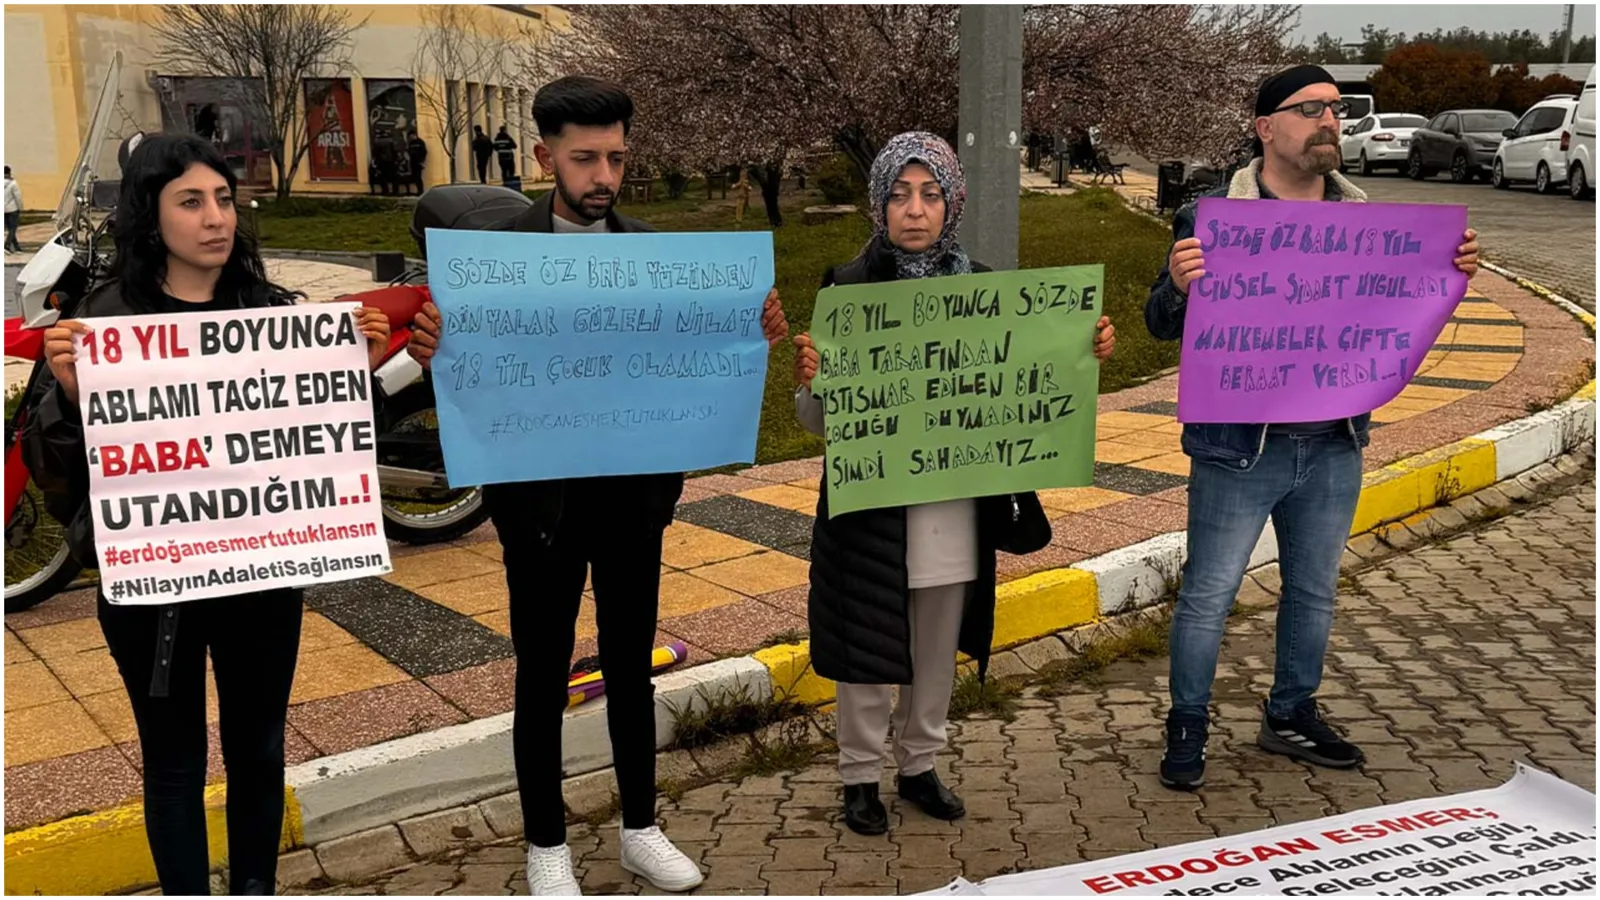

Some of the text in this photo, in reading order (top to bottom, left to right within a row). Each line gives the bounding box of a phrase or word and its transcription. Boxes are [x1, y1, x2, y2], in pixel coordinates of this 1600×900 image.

[1201, 219, 1422, 257] SÖZDE ÖZ BABA 18 YIL
[446, 255, 757, 290] SÖZDE ÖZ BABA YÜZÜNDEN
[1197, 271, 1448, 305] CİNSEL ŞİDDET UYGULADI
[573, 302, 663, 333] GÜZELİ
[676, 301, 757, 337] NİLAY
[826, 282, 1097, 337] 18 YIL BOYUNCA SÖZDE
[82, 312, 356, 365] 18 YIL BOYUNCA
[820, 330, 1012, 382] BABA TARAFINDAN
[1337, 323, 1412, 352] ÇİFTE
[451, 351, 483, 391] 18
[495, 353, 536, 387] YIL
[547, 352, 613, 386] ÇOCUK
[823, 362, 1060, 416] İSTİSMAR EDİLEN BİR
[1219, 363, 1296, 392] BERAAT
[87, 368, 368, 426] ABLAMI TACİZ EDEN
[225, 420, 373, 465] DEMEYE
[825, 394, 1076, 448] ÇOCUĞU DUYMADINIZ
[832, 450, 885, 490] ŞİMDİ
[100, 473, 372, 531] UTANDIĞIM..!
[104, 521, 377, 567] #erdoğanesmertutuklansın
[110, 552, 383, 600] #NilayınAdaletiSağlansın
[1082, 807, 1499, 894] ERDOĞAN ESMER;
[1268, 842, 1425, 882] Ablamın
[1422, 822, 1538, 850] Değil,
[1281, 850, 1491, 896] Geleceğini
